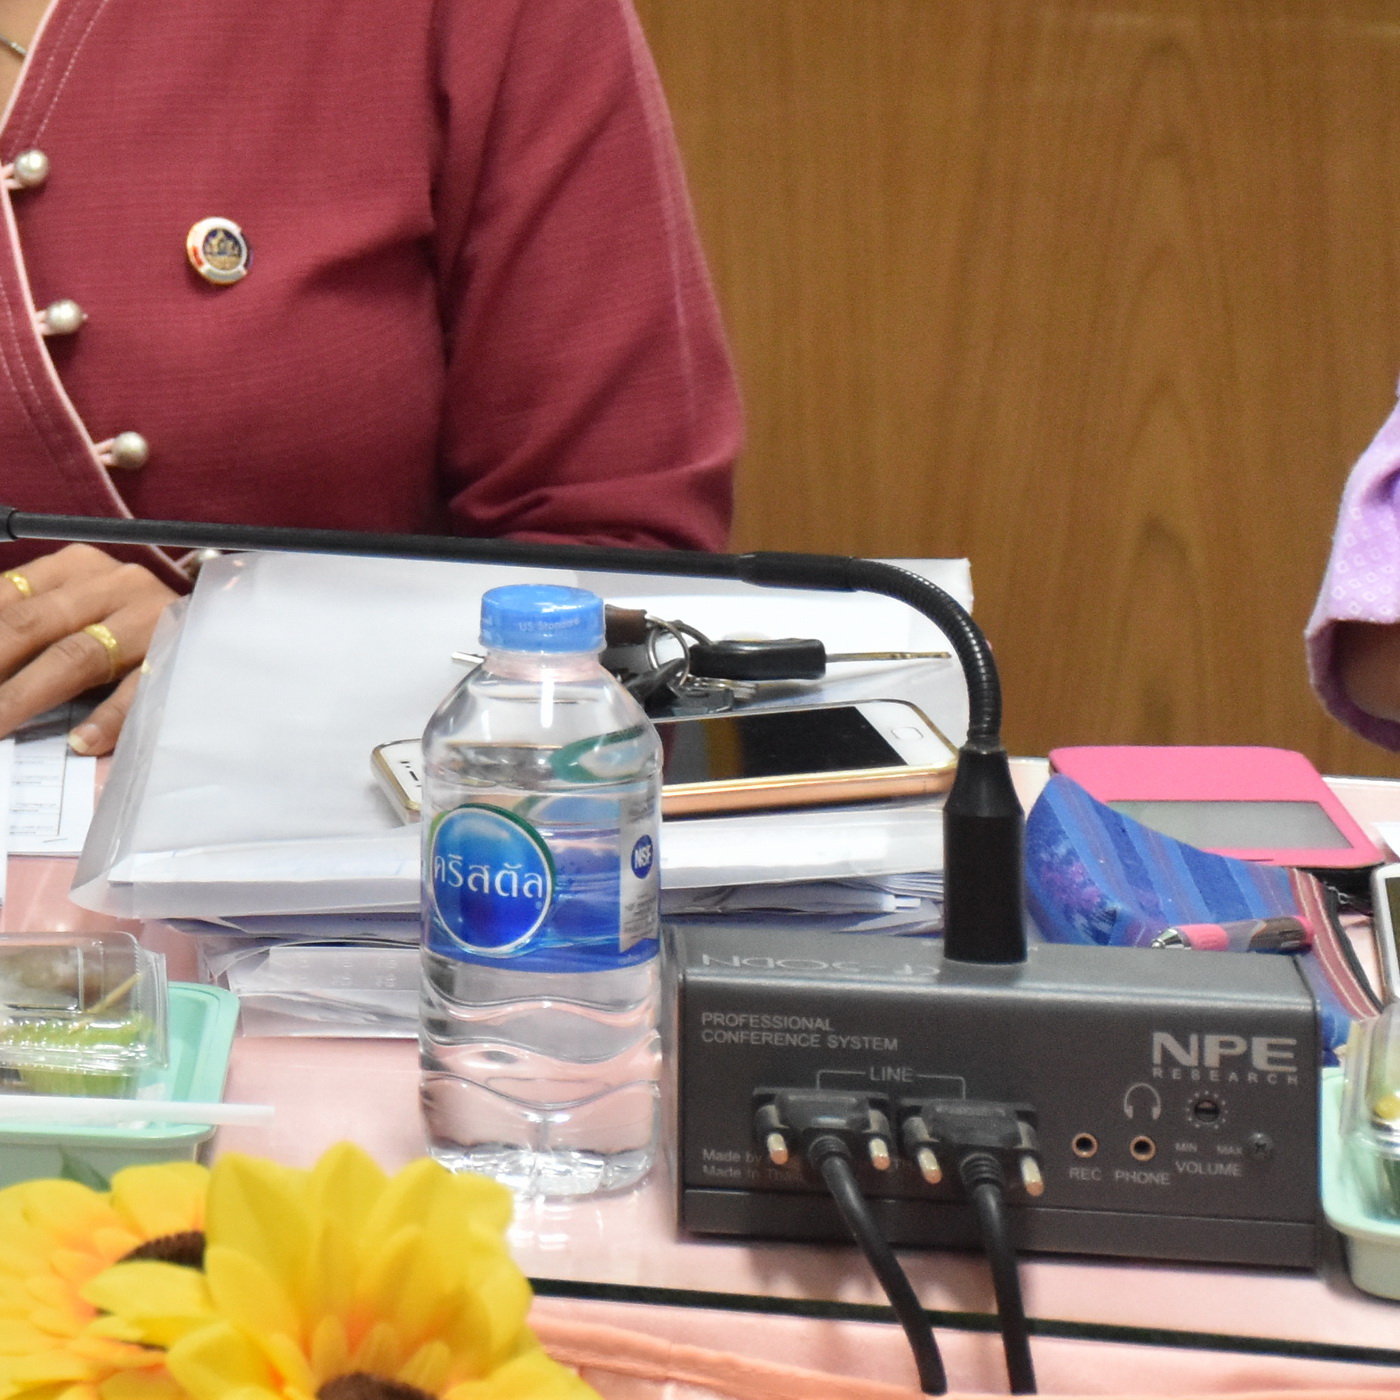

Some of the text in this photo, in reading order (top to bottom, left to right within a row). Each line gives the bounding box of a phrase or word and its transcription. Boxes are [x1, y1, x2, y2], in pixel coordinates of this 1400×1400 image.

[435, 853, 543, 898] คริสตัล
[701, 1011, 836, 1032] PROFESSIONAL
[701, 1029, 899, 1051] CONFERENCE SYSTEM
[1152, 1031, 1299, 1073] NPE
[869, 1065, 914, 1083] LINE
[1152, 1066, 1299, 1085] RESEARCH
[1175, 1141, 1198, 1152] MIN
[702, 1148, 741, 1164] Made
[1069, 1166, 1102, 1181] REC
[1115, 1169, 1171, 1186] PHONE
[1175, 1160, 1243, 1178] VOLUME
